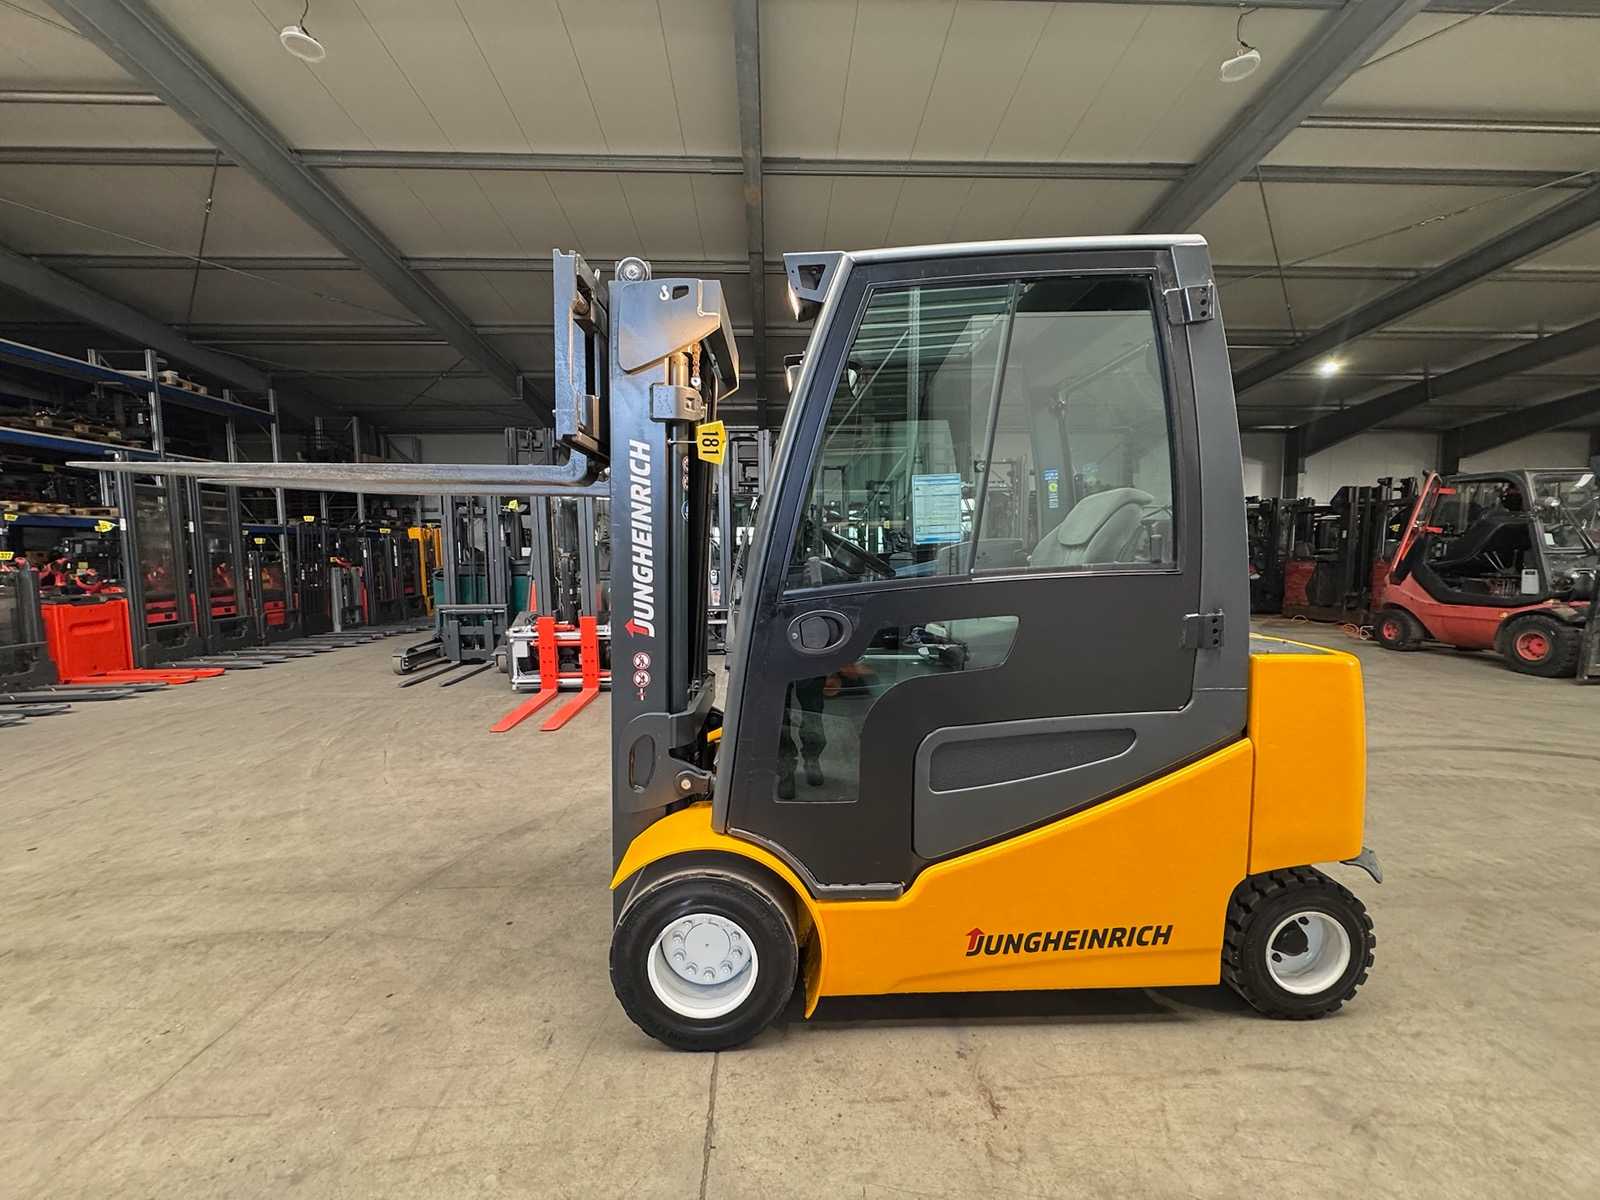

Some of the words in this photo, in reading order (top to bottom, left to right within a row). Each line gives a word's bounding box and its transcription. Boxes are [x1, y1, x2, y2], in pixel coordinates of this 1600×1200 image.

[702, 431, 720, 455] 181
[625, 439, 655, 638] JUNGHEINRICH
[966, 925, 1173, 956] JUNGHEINRICH
